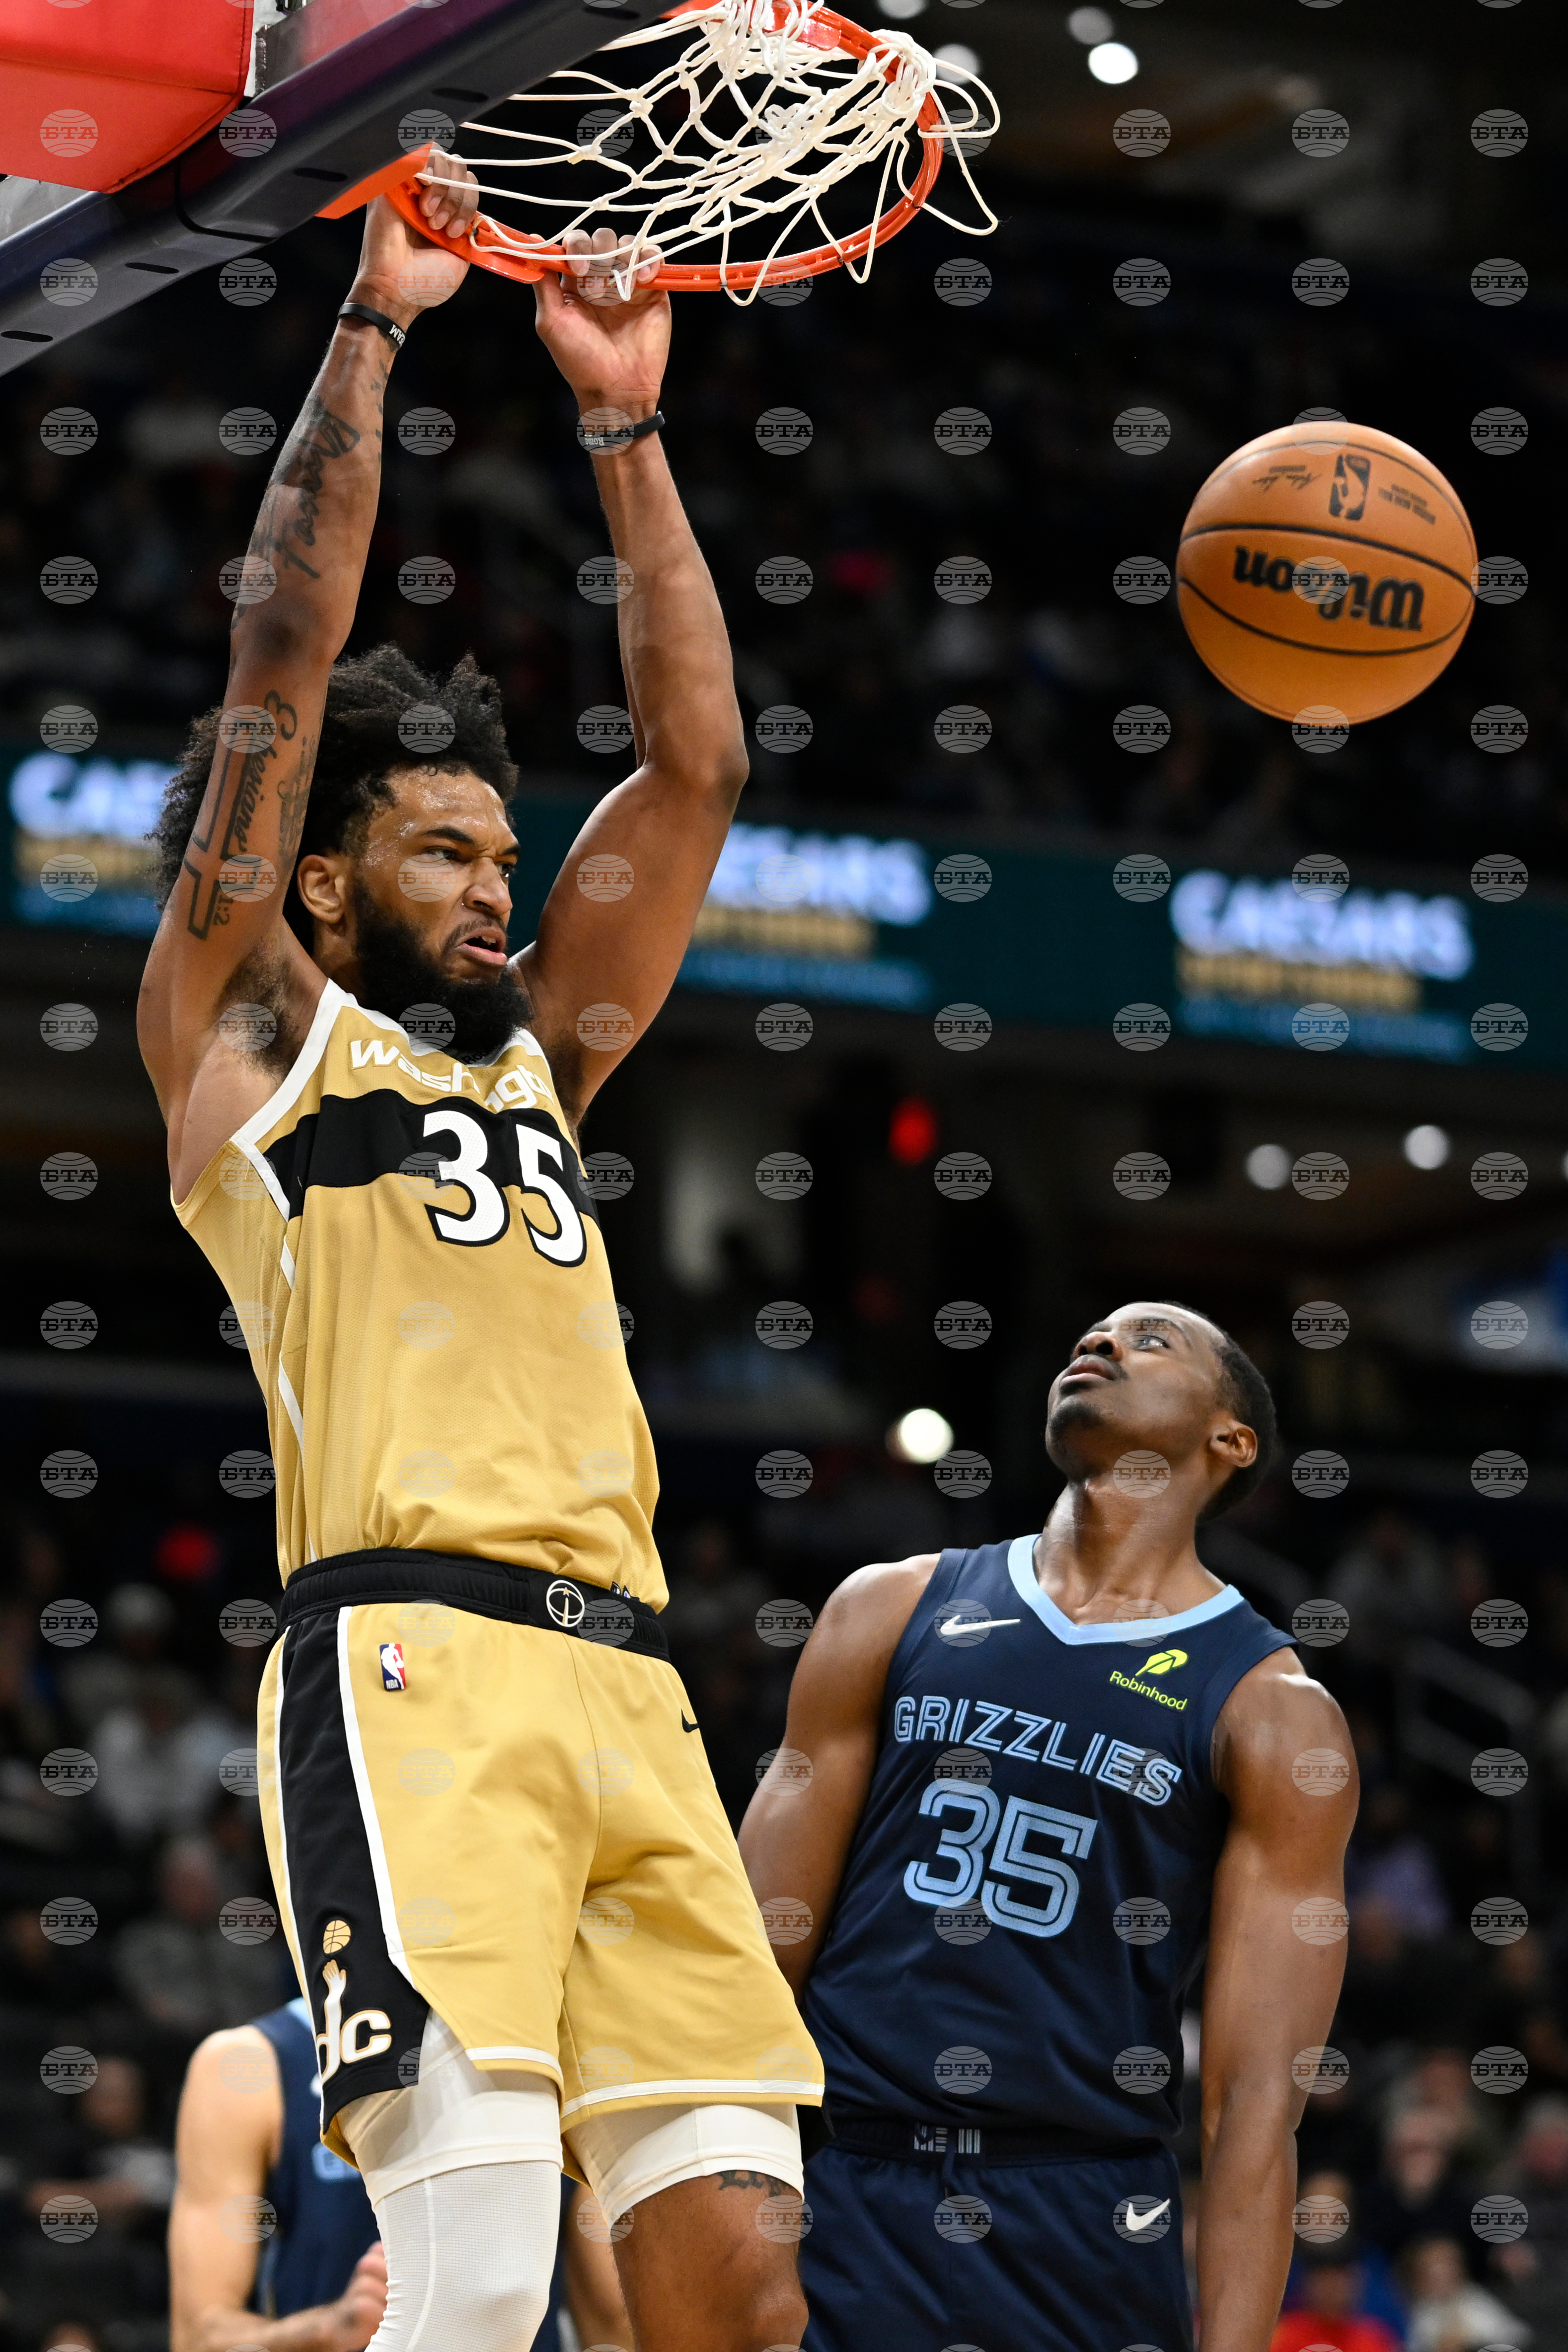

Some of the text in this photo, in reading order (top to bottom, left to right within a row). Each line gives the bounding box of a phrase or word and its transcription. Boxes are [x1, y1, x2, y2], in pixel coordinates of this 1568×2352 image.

[1234, 547, 1421, 631] Wilson
[423, 1109, 587, 1267] 35
[385, 1679, 399, 1690] NBA
[1110, 1671, 1188, 1710] Robinhood
[895, 1695, 1182, 1806] GRIZZLIES
[903, 1778, 1098, 1937] 35
